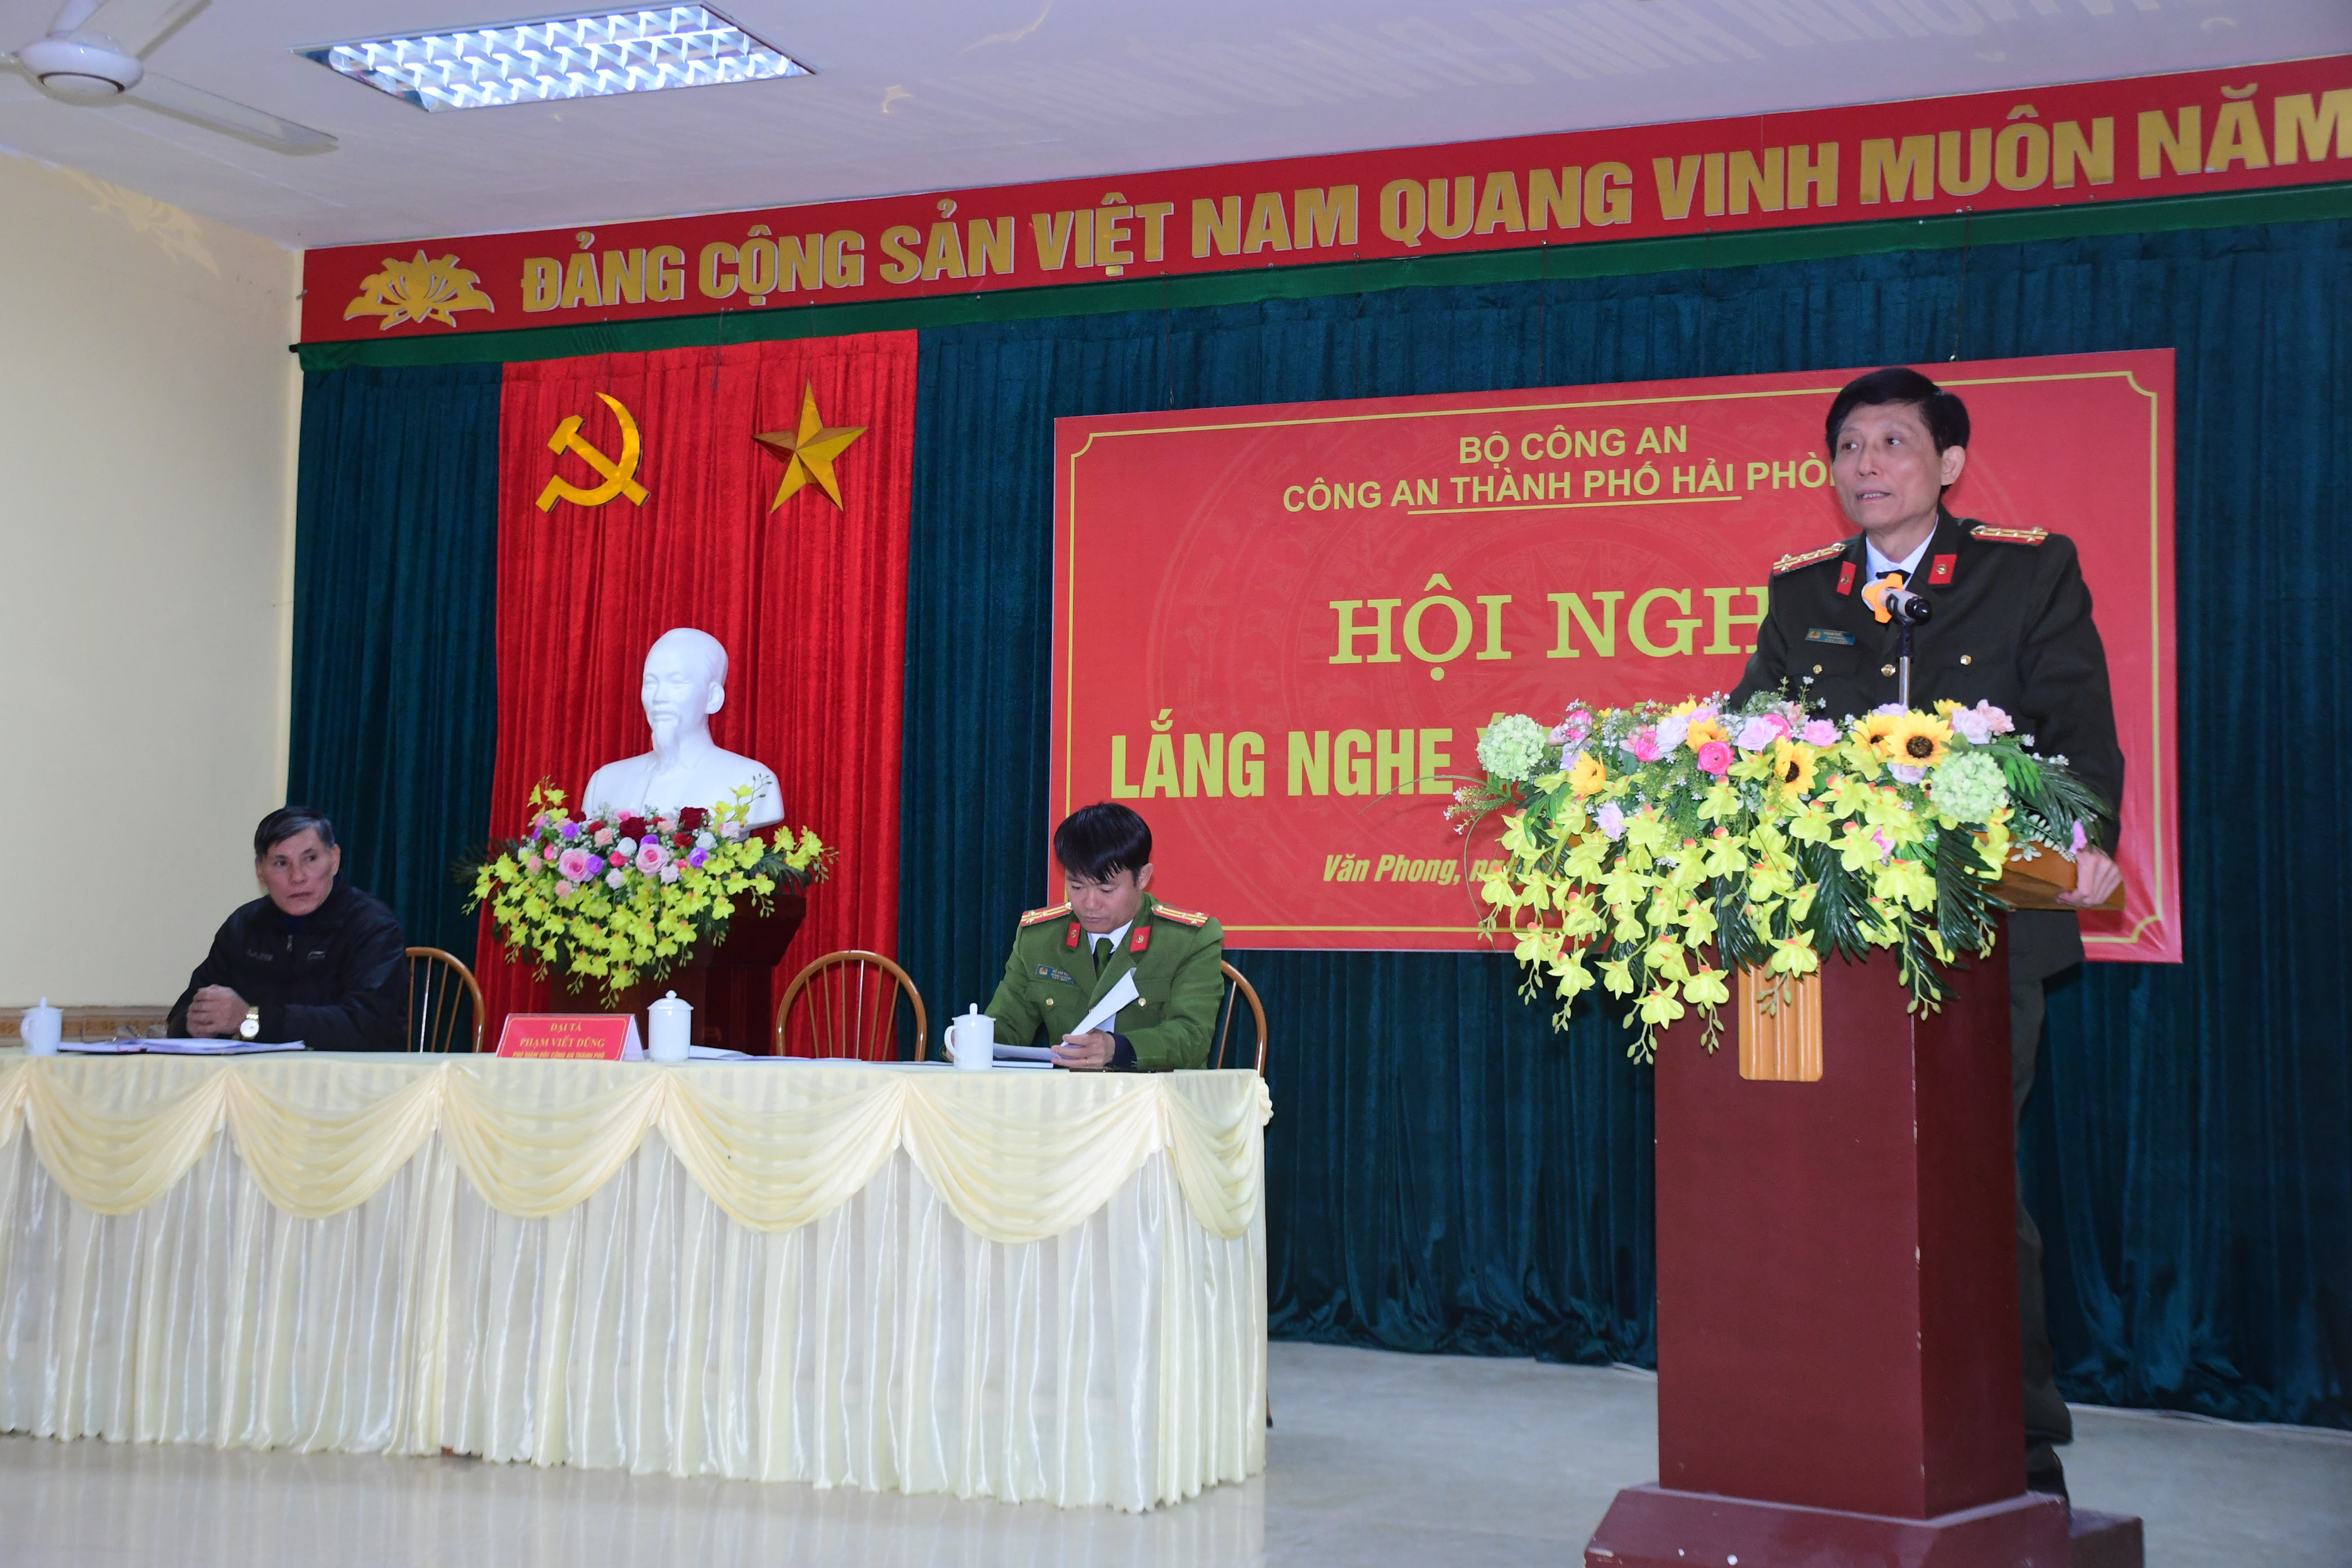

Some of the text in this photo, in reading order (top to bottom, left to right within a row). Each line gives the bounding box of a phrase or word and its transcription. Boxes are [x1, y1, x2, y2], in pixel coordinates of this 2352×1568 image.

[522, 84, 2352, 311] ĐẢNG CỘNG SẢN VIỆT NAM QUANG VINH MUÔN NĂM
[1459, 425, 1686, 470] BỘ CÔNG AN
[1284, 452, 1834, 511] CÔNG AN THÀNH PHỐ HẢI PHÒ
[1329, 573, 1769, 680] HỘI NGH
[1112, 709, 1264, 799] LẮNG
[1289, 728, 1453, 796] NGHE
[1324, 854, 1369, 882] Văn
[1375, 855, 1460, 885] Phong,
[519, 1037, 550, 1049] PHẠM
[552, 1035, 574, 1047] VIẾT
[550, 1021, 582, 1033] ĐẠI TÁ
